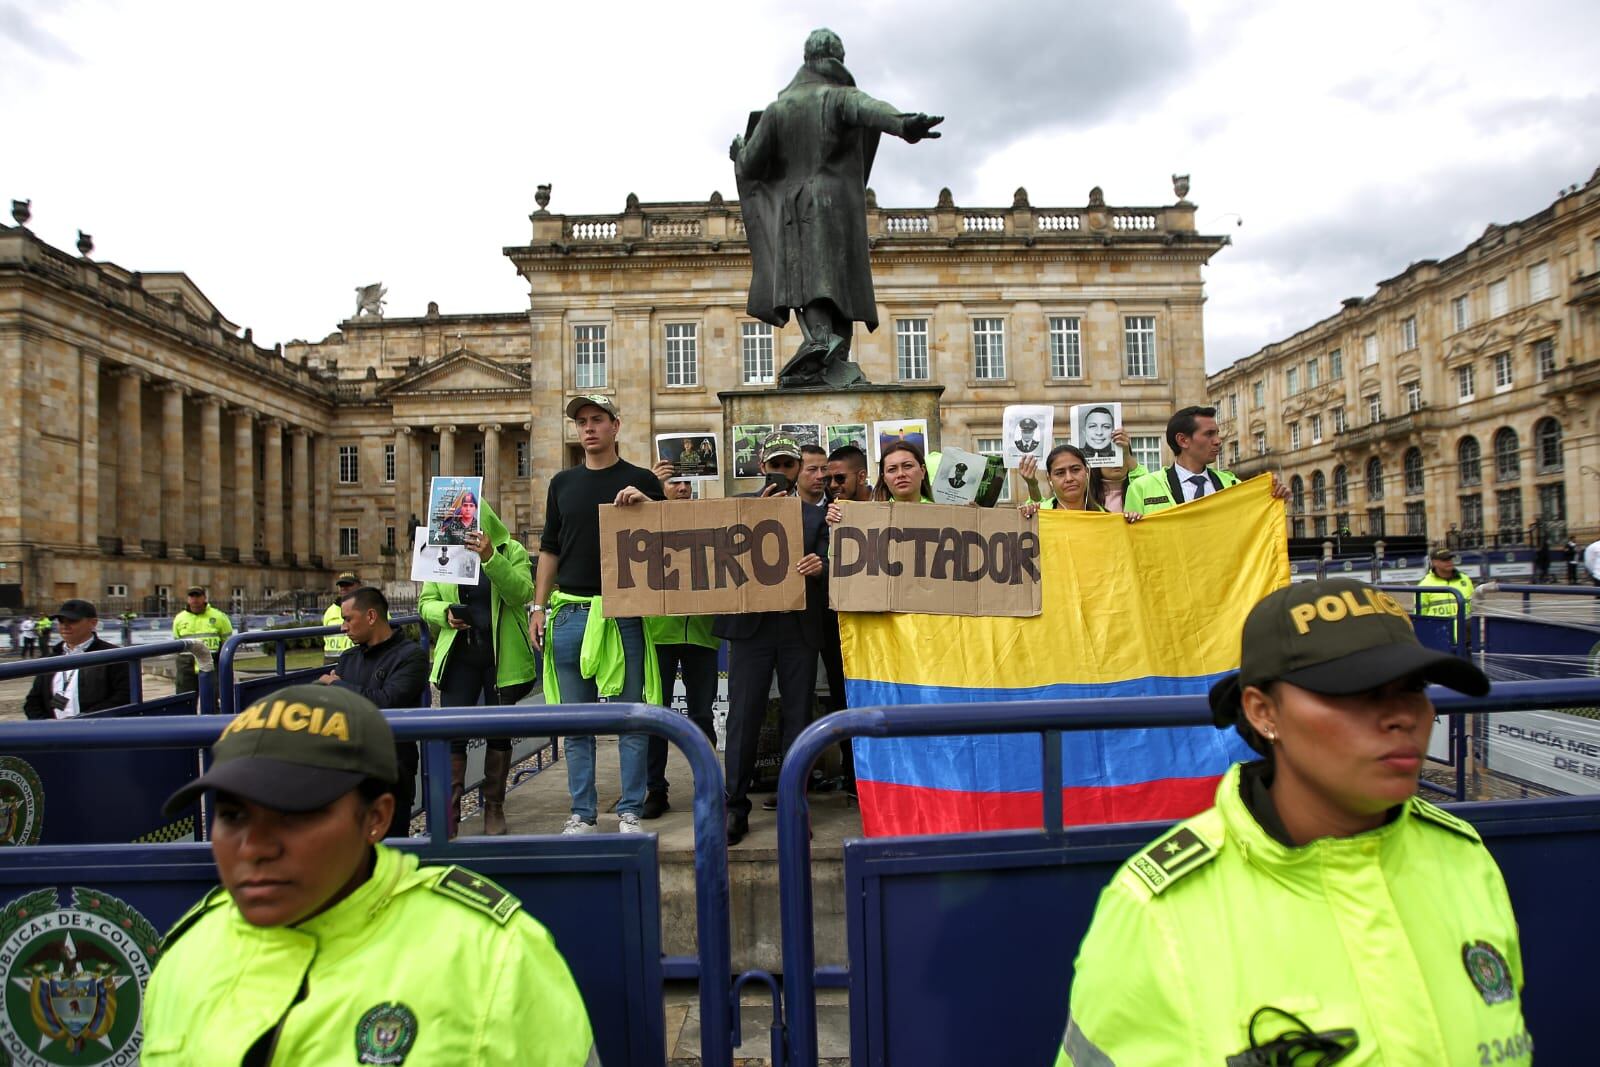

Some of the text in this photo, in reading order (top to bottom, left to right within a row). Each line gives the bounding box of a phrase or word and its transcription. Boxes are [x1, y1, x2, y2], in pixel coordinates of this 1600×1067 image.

[616, 519, 789, 591] PETRO
[833, 526, 1041, 585] DICTADOR
[11, 773, 33, 816] COLOMBIA
[58, 914, 81, 926] DE
